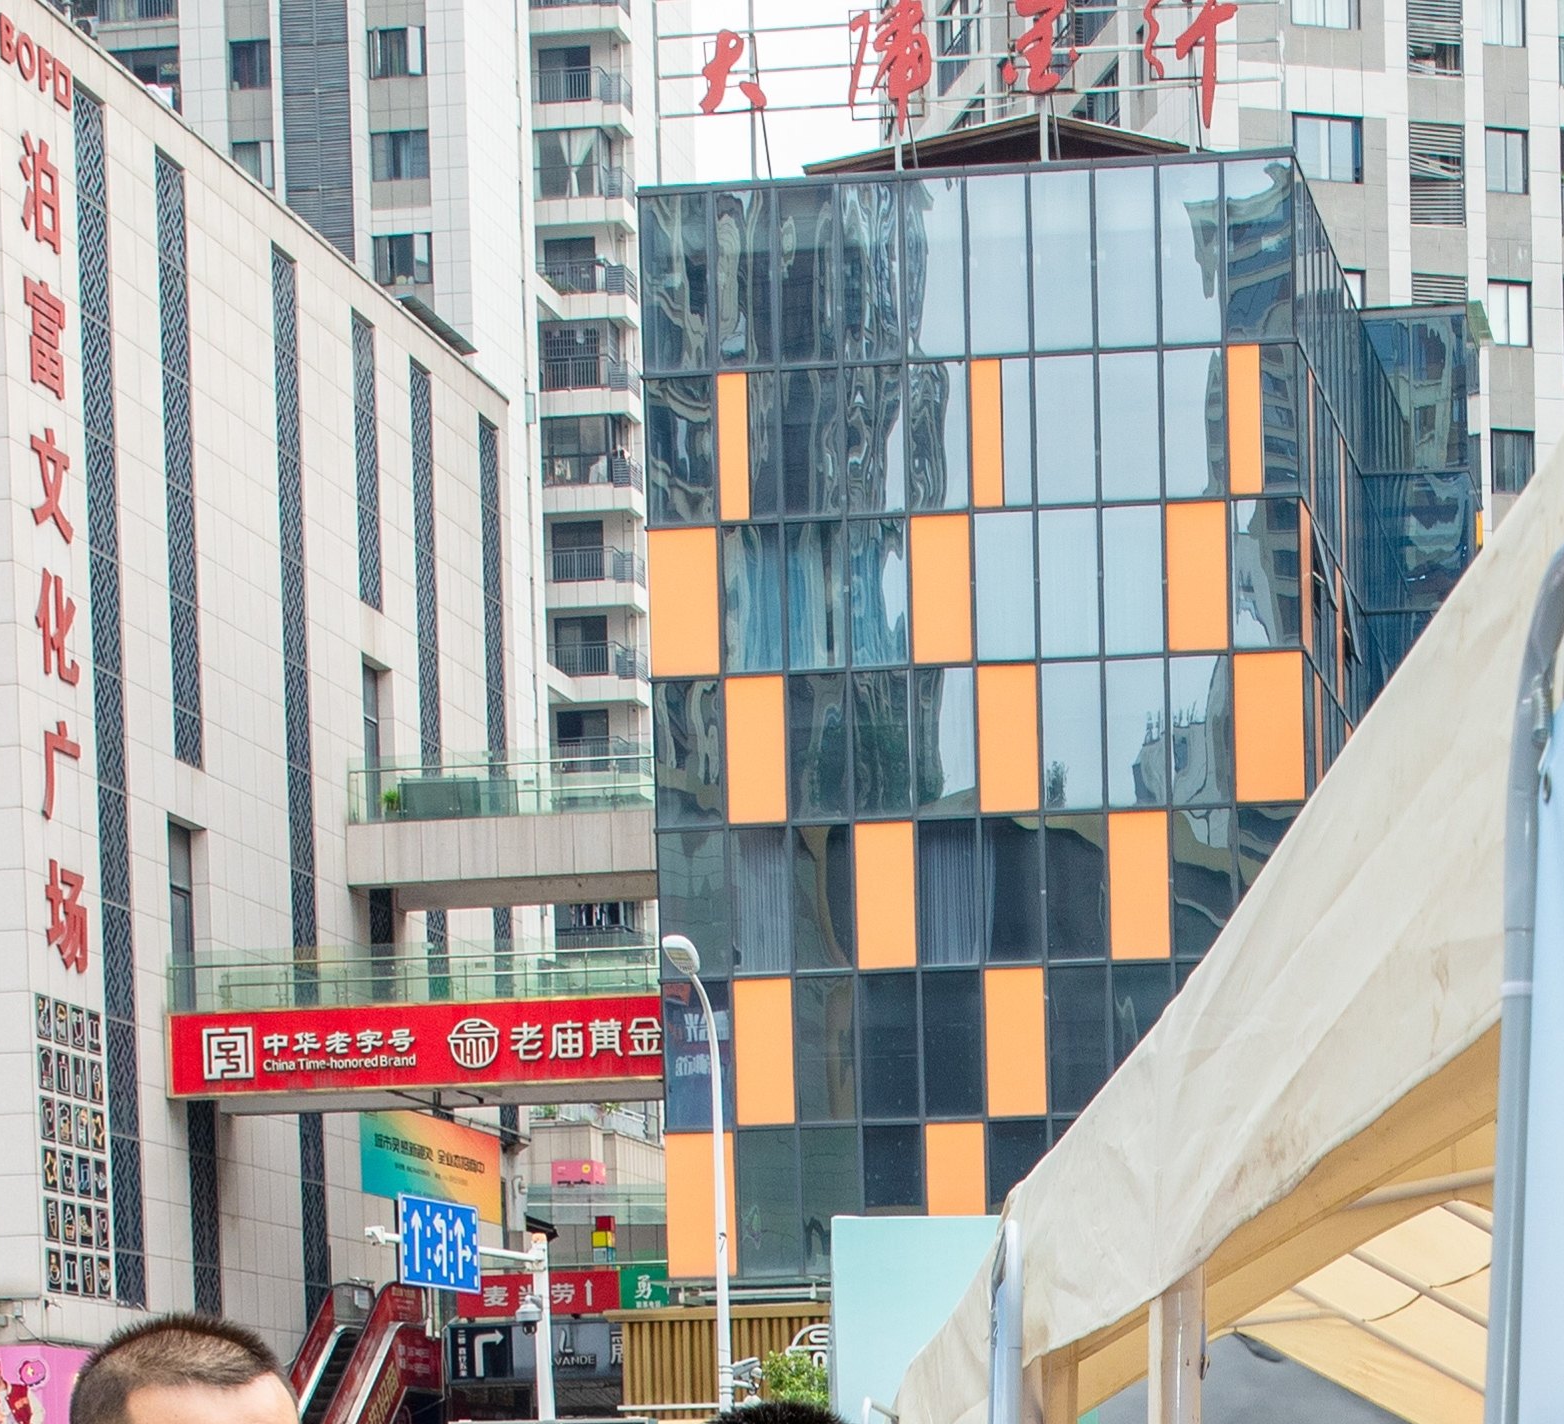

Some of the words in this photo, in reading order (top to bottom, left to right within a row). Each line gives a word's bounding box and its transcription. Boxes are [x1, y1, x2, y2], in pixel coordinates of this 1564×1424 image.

[20, 129, 89, 977] 泊富文化广场
[262, 1028, 417, 1053] 中华老字号
[509, 1017, 662, 1061] 老庙黄金
[262, 1057, 295, 1072] China
[297, 1055, 378, 1071] Time-honored
[379, 1053, 417, 1069] Brand
